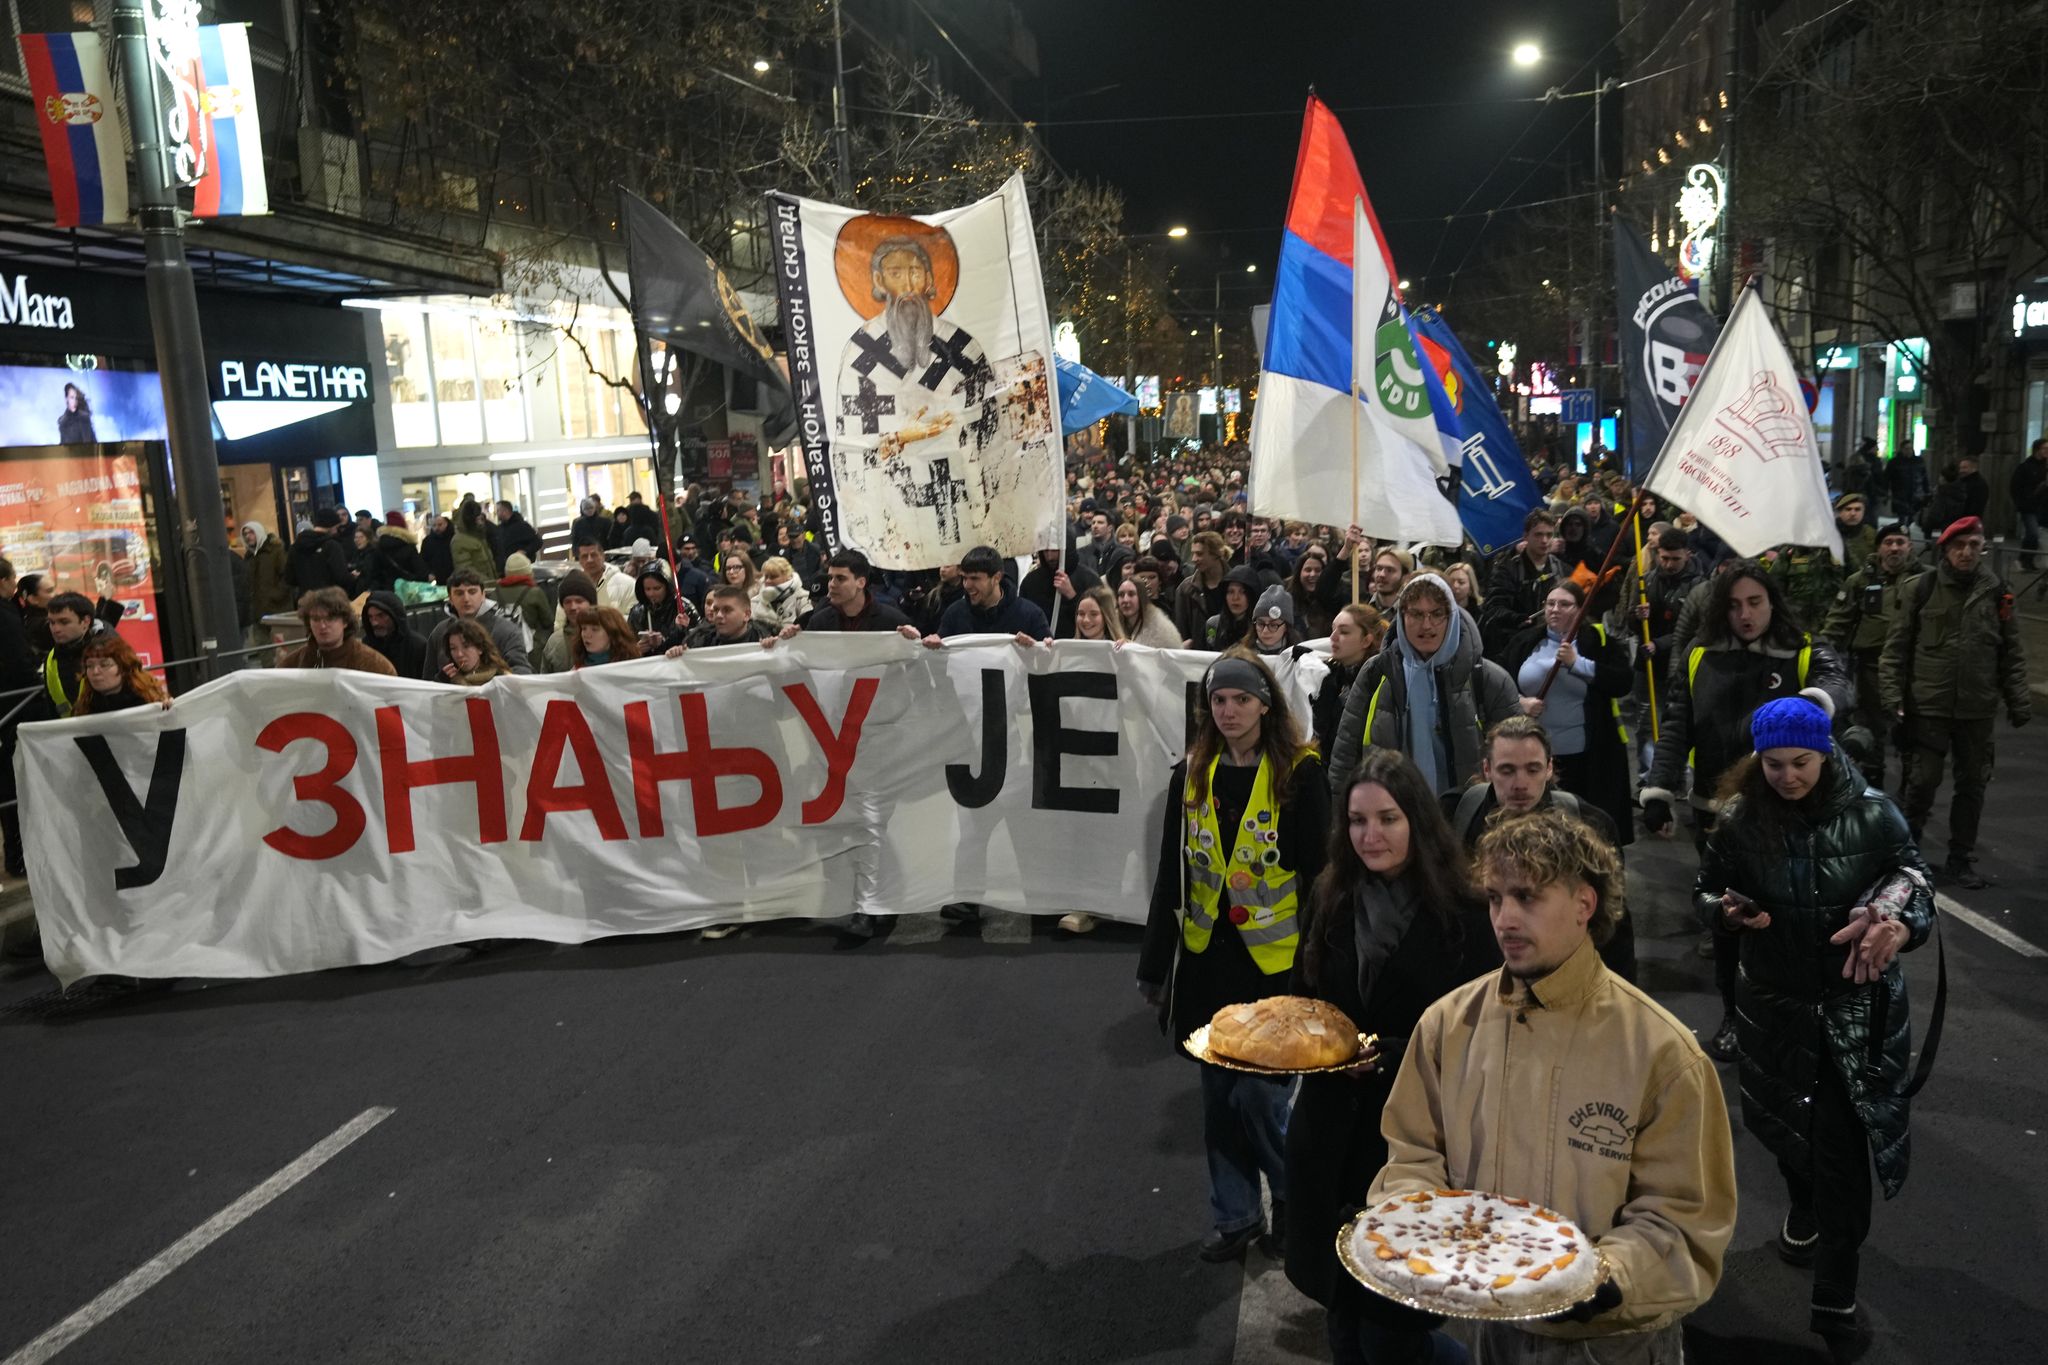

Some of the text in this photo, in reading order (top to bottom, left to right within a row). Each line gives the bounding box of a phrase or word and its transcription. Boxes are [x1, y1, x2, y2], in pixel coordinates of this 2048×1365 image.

[777, 205, 800, 279] склад
[0, 272, 74, 330] Mara
[790, 299, 811, 373] закон
[1380, 373, 1420, 411] FDU
[802, 403, 825, 476] закон
[1707, 434, 1743, 458] 1838
[818, 494, 840, 558] нање
[73, 728, 186, 891] У
[254, 678, 879, 861] ЗНАЊУ
[944, 668, 1120, 813] ЈЕ
[1568, 1101, 1637, 1142] CHEVROLE
[1568, 1137, 1632, 1161] TRUCK SERVIC
